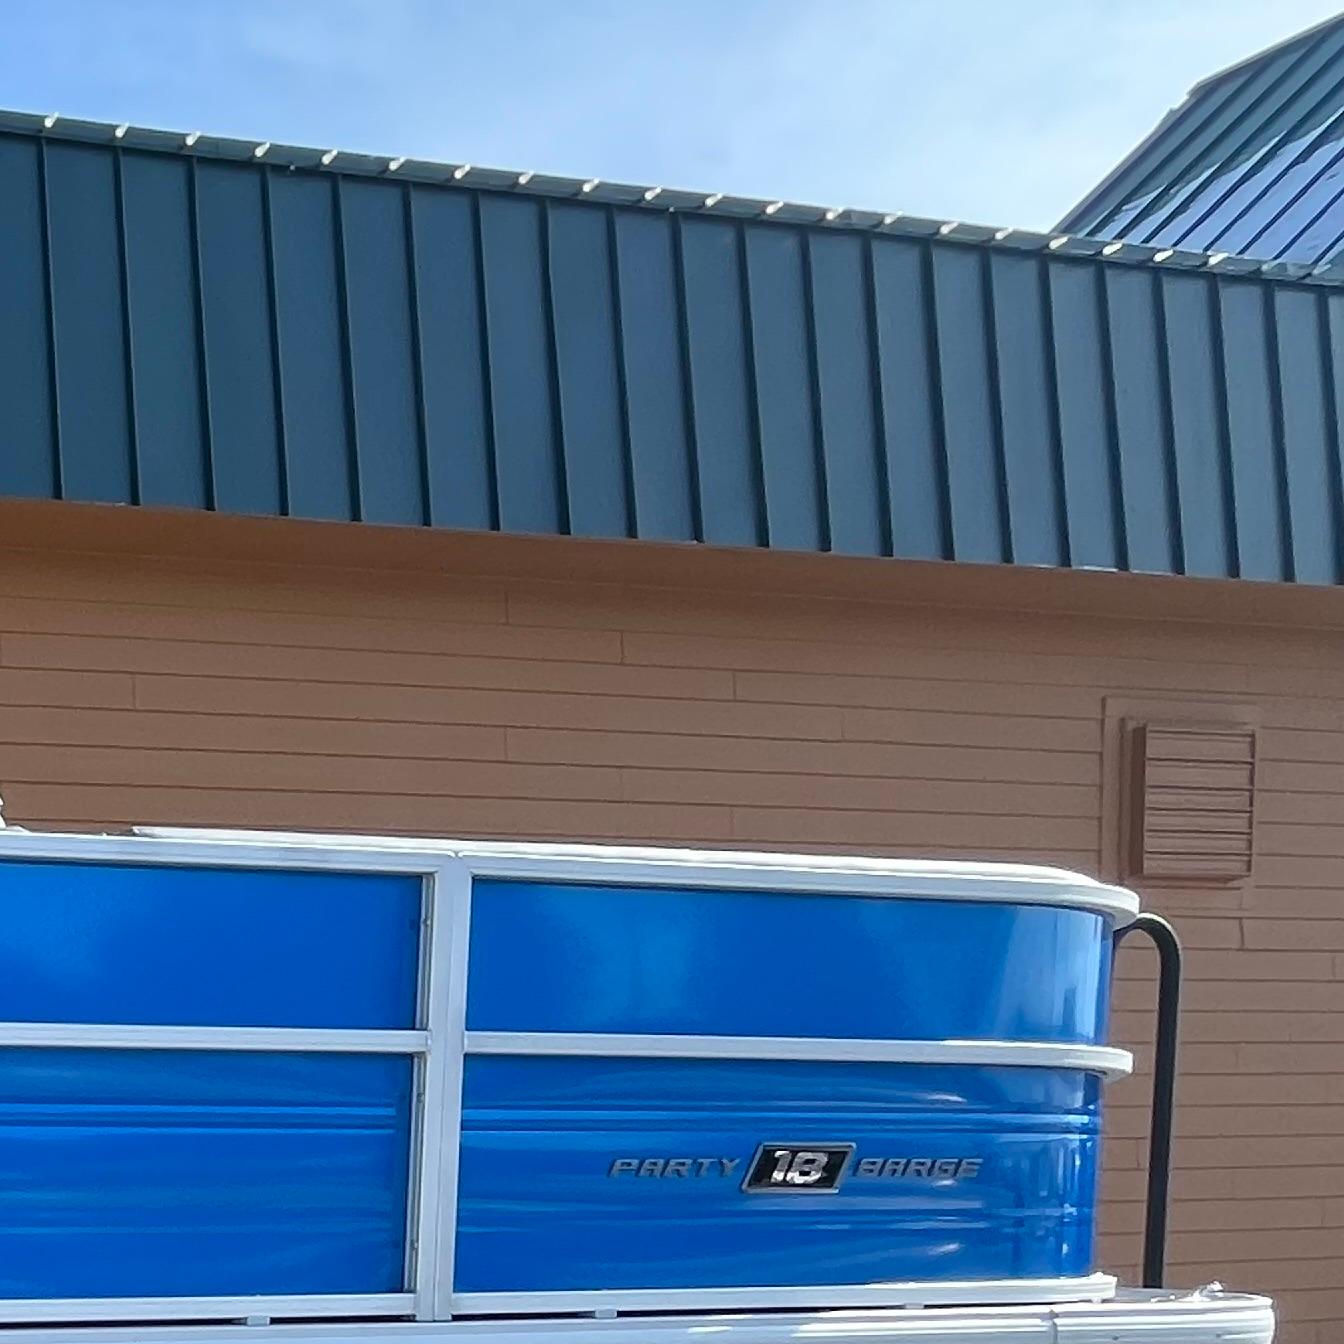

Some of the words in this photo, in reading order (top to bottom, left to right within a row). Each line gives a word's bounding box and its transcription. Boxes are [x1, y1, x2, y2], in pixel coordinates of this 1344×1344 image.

[609, 1157, 740, 1179] PARTY
[769, 1150, 830, 1185] 18
[853, 1157, 984, 1180] BARGE
